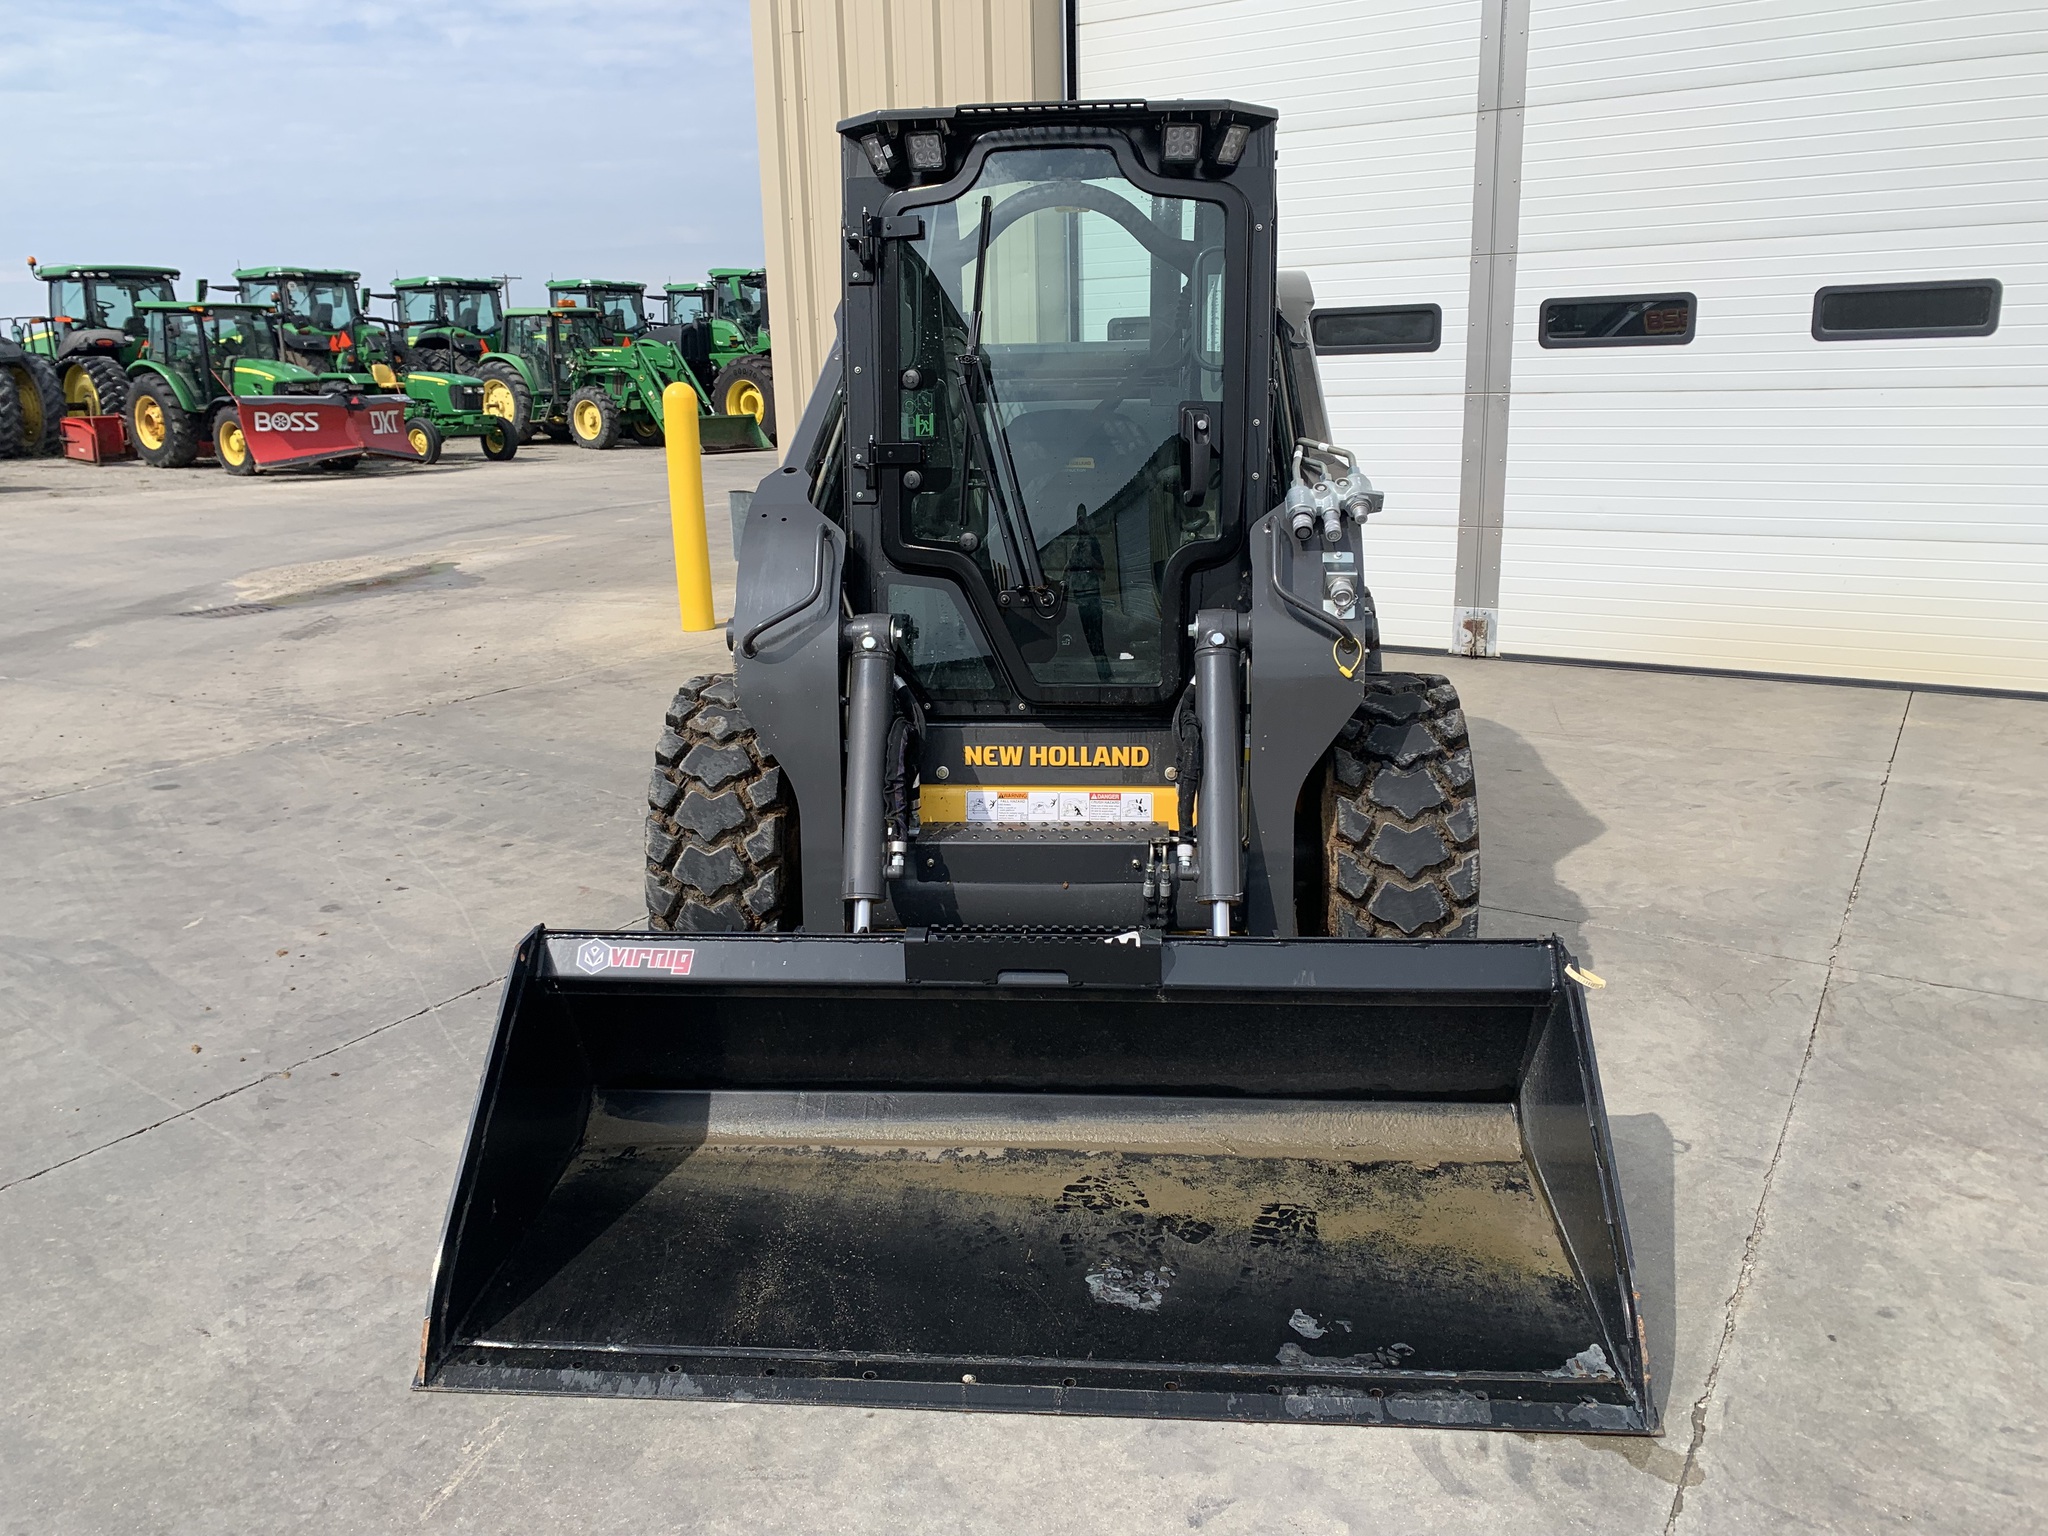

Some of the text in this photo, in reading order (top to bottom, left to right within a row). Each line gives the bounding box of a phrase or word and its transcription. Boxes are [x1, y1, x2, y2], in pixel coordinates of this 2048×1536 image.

[254, 411, 319, 432] BOSS
[964, 745, 1150, 767] NEW HOLLAND
